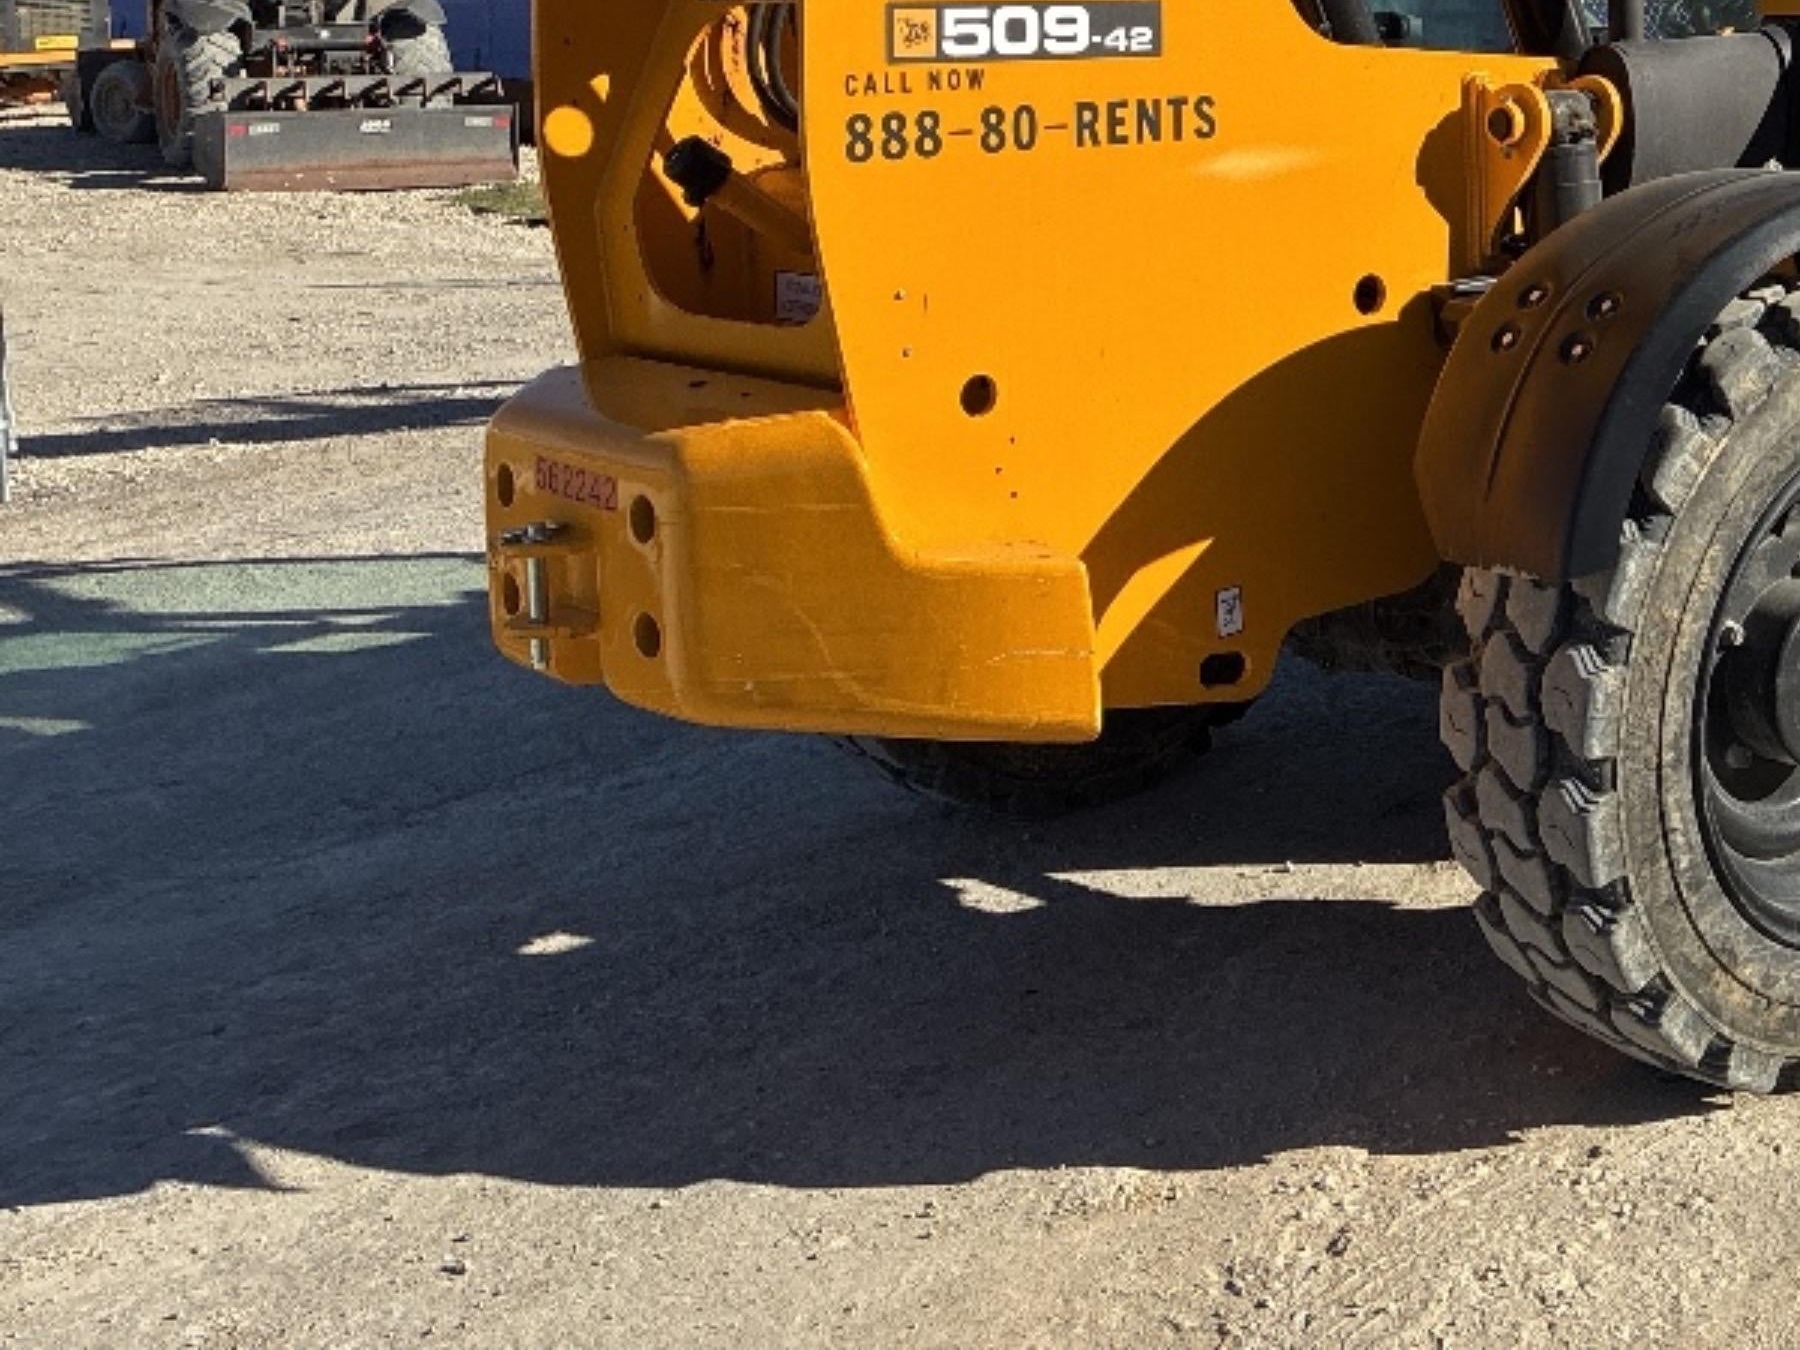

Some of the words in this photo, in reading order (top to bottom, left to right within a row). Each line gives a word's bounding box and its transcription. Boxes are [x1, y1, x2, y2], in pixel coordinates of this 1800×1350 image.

[940, 5, 1154, 57] 509-42
[845, 72, 913, 98] CALL
[927, 67, 986, 92] NOW
[845, 95, 1217, 163] 888-80-RENTS
[535, 454, 619, 511] 562242
